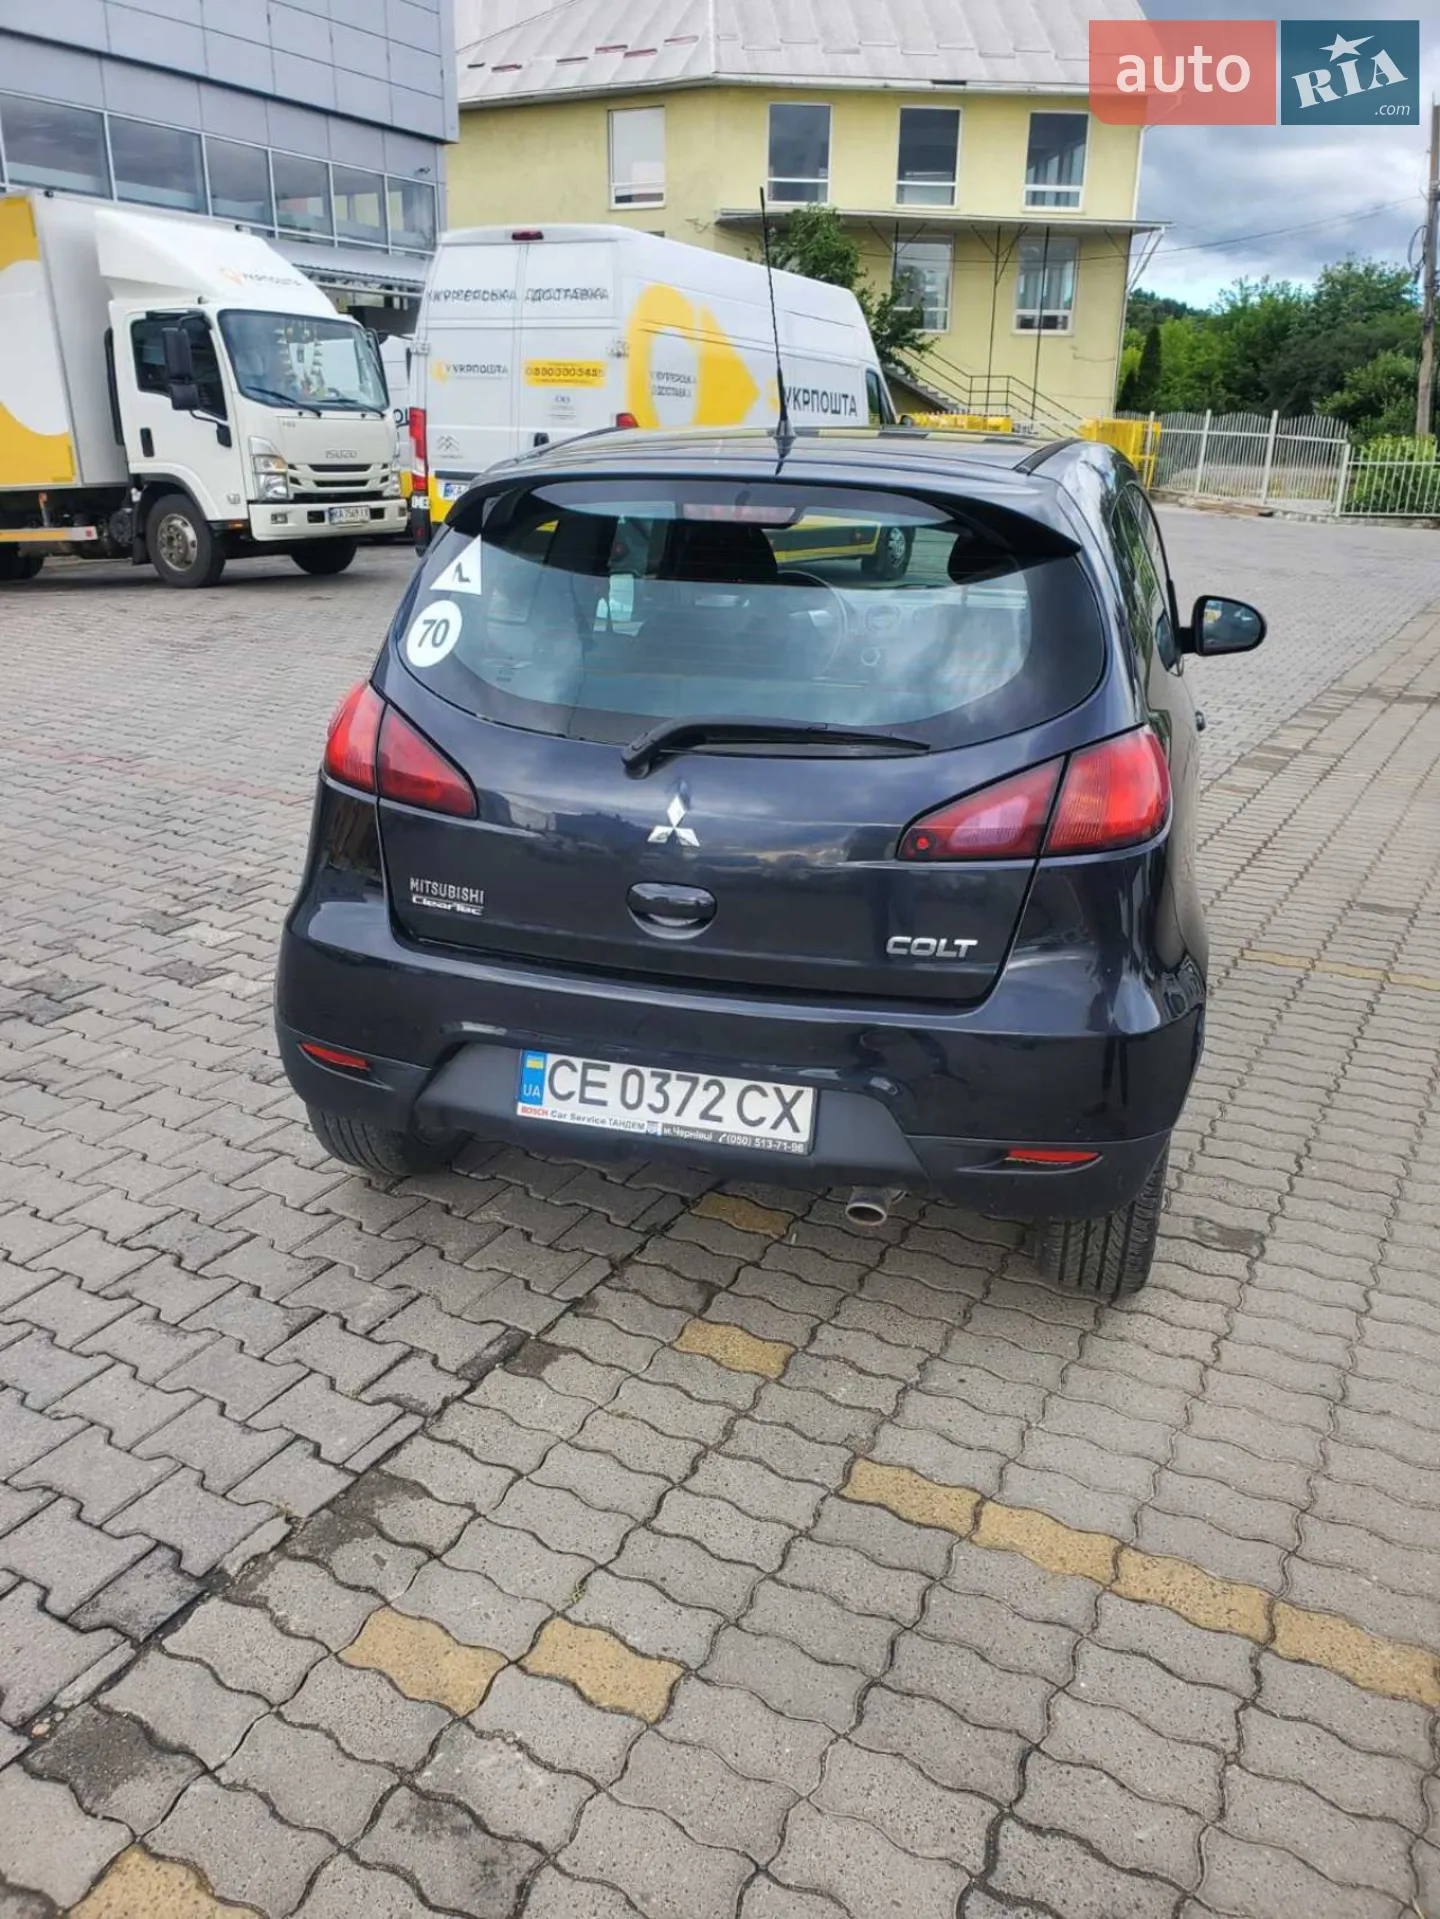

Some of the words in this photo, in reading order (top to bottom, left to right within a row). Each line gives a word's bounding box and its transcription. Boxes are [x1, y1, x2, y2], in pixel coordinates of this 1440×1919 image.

[785, 385, 858, 417] УКРПОШТА
[417, 618, 450, 648] 70
[409, 876, 485, 905] MITSUBISHI
[885, 935, 979, 959] COLT
[523, 1083, 541, 1097] UA
[547, 1058, 611, 1107] CE
[619, 1067, 727, 1123] 0372
[736, 1083, 805, 1134] CX
[520, 1105, 549, 1117] BOSCH
[550, 1109, 568, 1119] Car
[569, 1112, 607, 1125] Service
